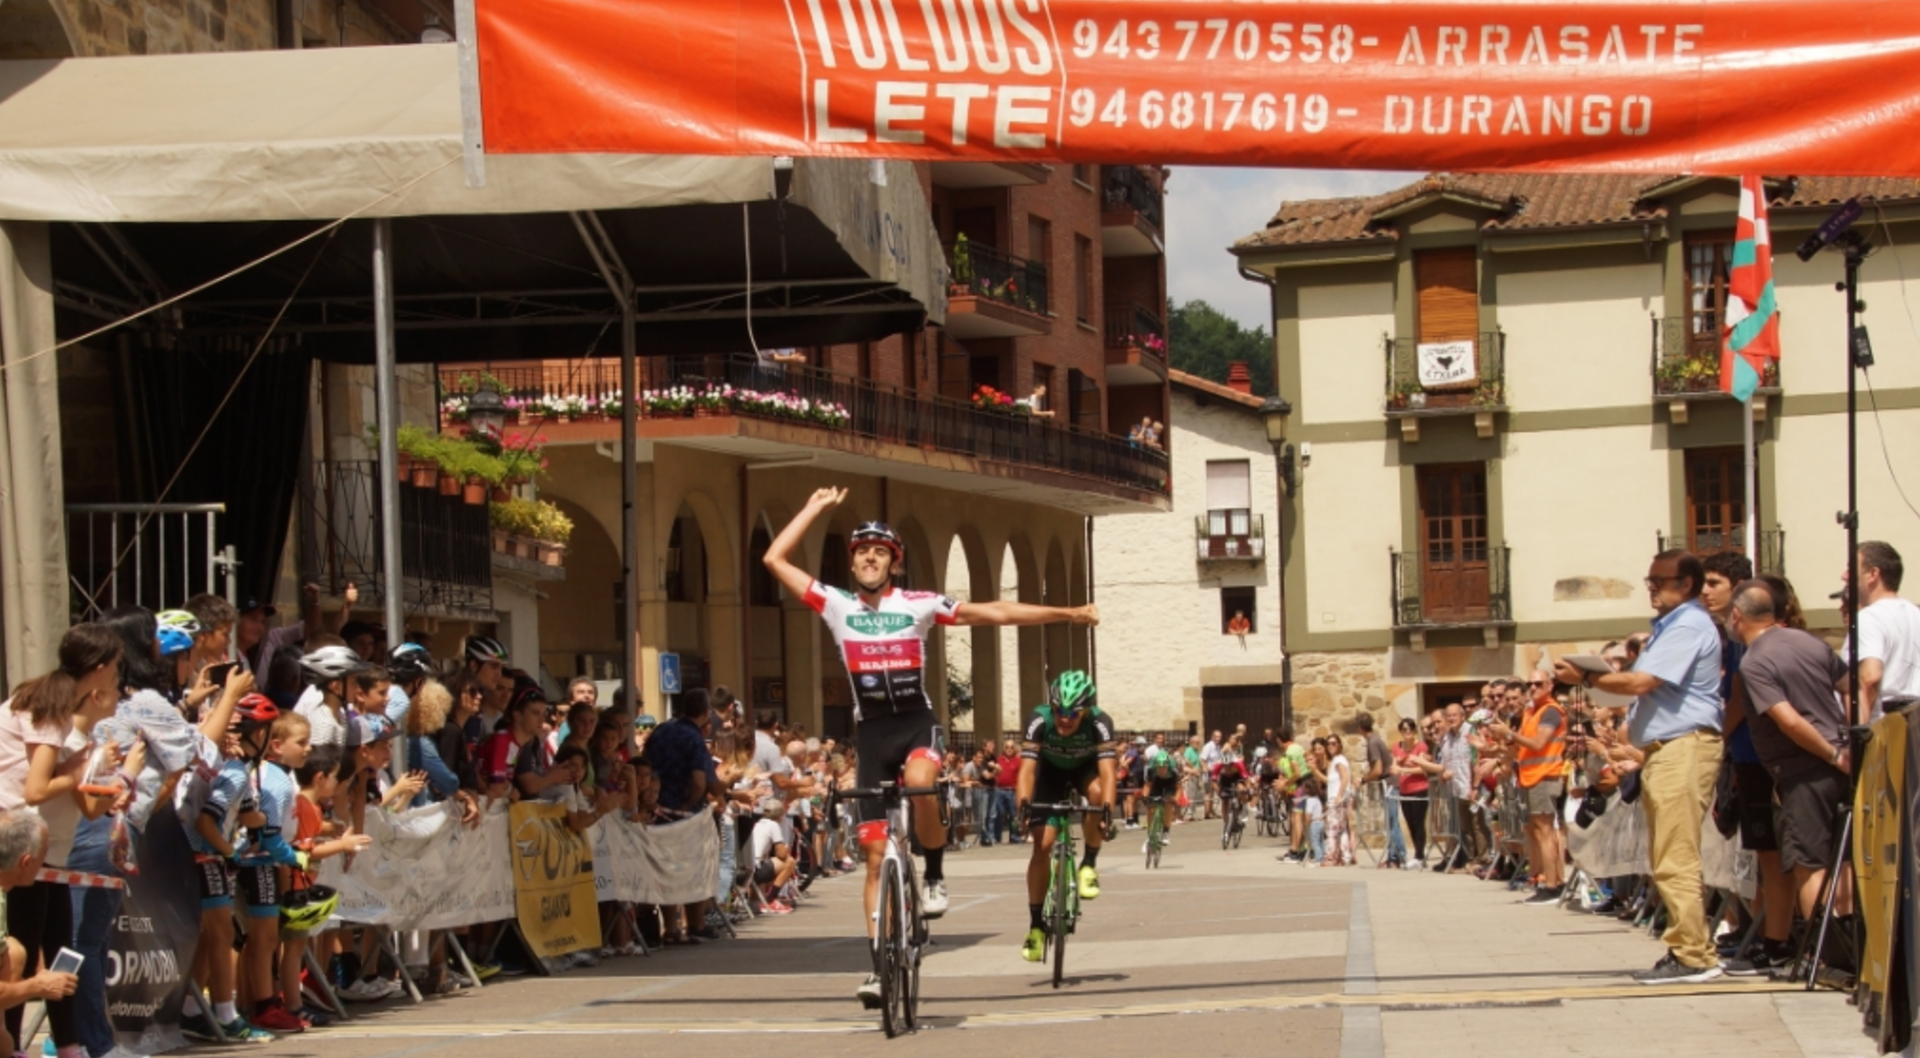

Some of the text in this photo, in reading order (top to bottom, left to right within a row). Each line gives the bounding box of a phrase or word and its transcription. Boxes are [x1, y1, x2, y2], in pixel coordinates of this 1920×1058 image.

[1396, 23, 1704, 66] ARRASATE
[813, 79, 1052, 149] LETE
[1383, 94, 1652, 136] DURANGO
